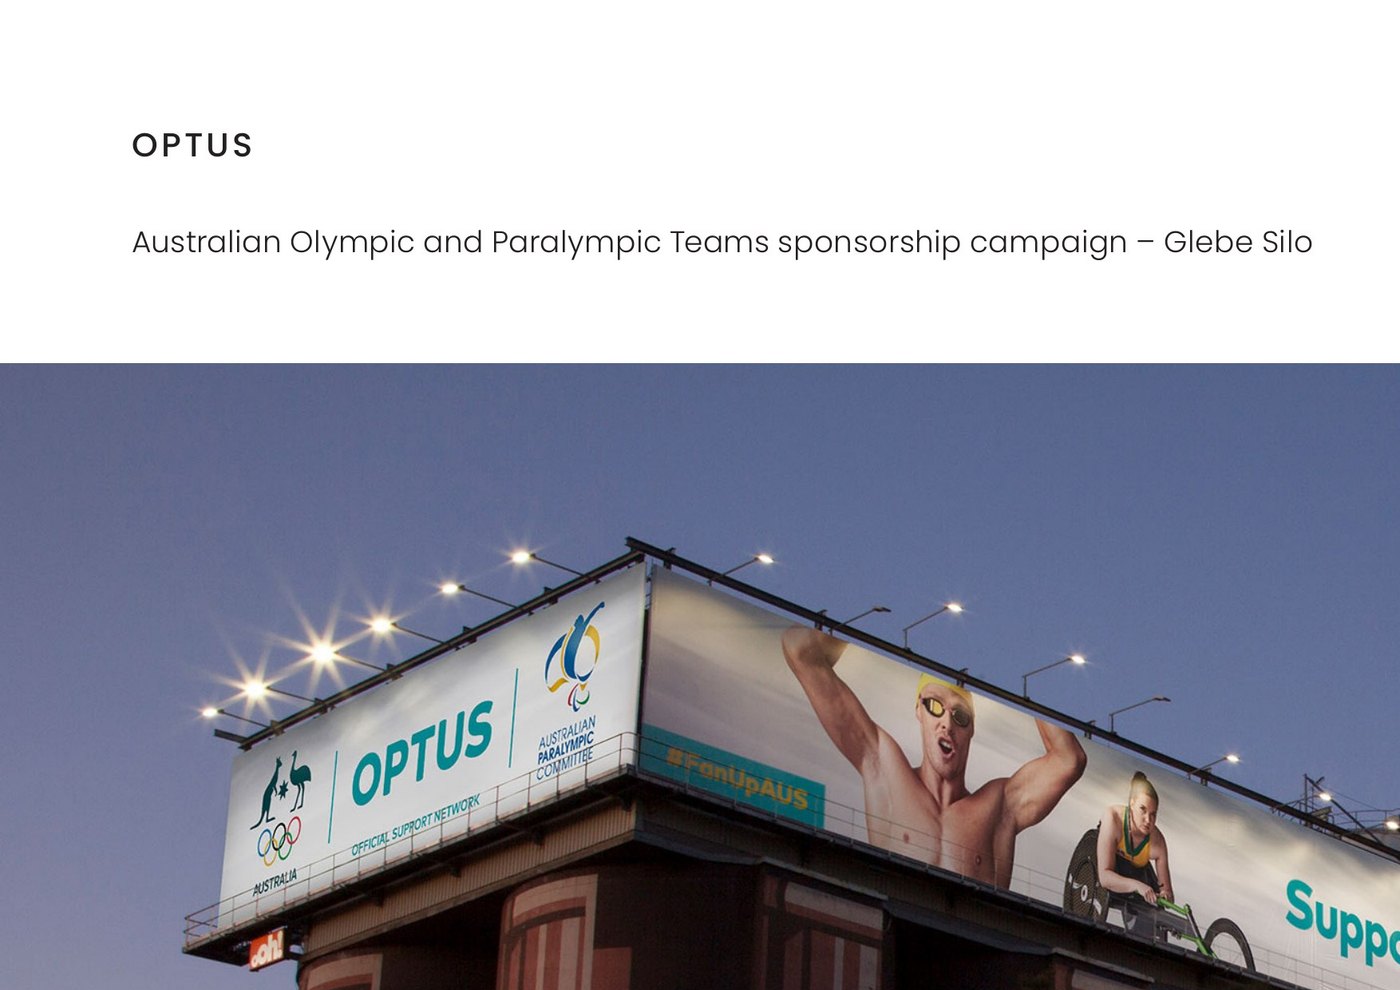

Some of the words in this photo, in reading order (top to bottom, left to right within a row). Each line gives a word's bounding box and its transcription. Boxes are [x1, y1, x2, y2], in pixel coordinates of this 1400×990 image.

[537, 730, 595, 765] PARALYMPIC
[538, 715, 596, 750] AUSTRALIAN
[351, 700, 494, 807] OPTUS
[536, 747, 594, 780] COMMITTEE
[667, 747, 809, 810] #FanUpAUS
[351, 833, 390, 857] OFFICIAL
[392, 813, 433, 838] SUPPORT
[433, 793, 481, 823] NETWORK
[252, 867, 298, 897] AUSTRALIA
